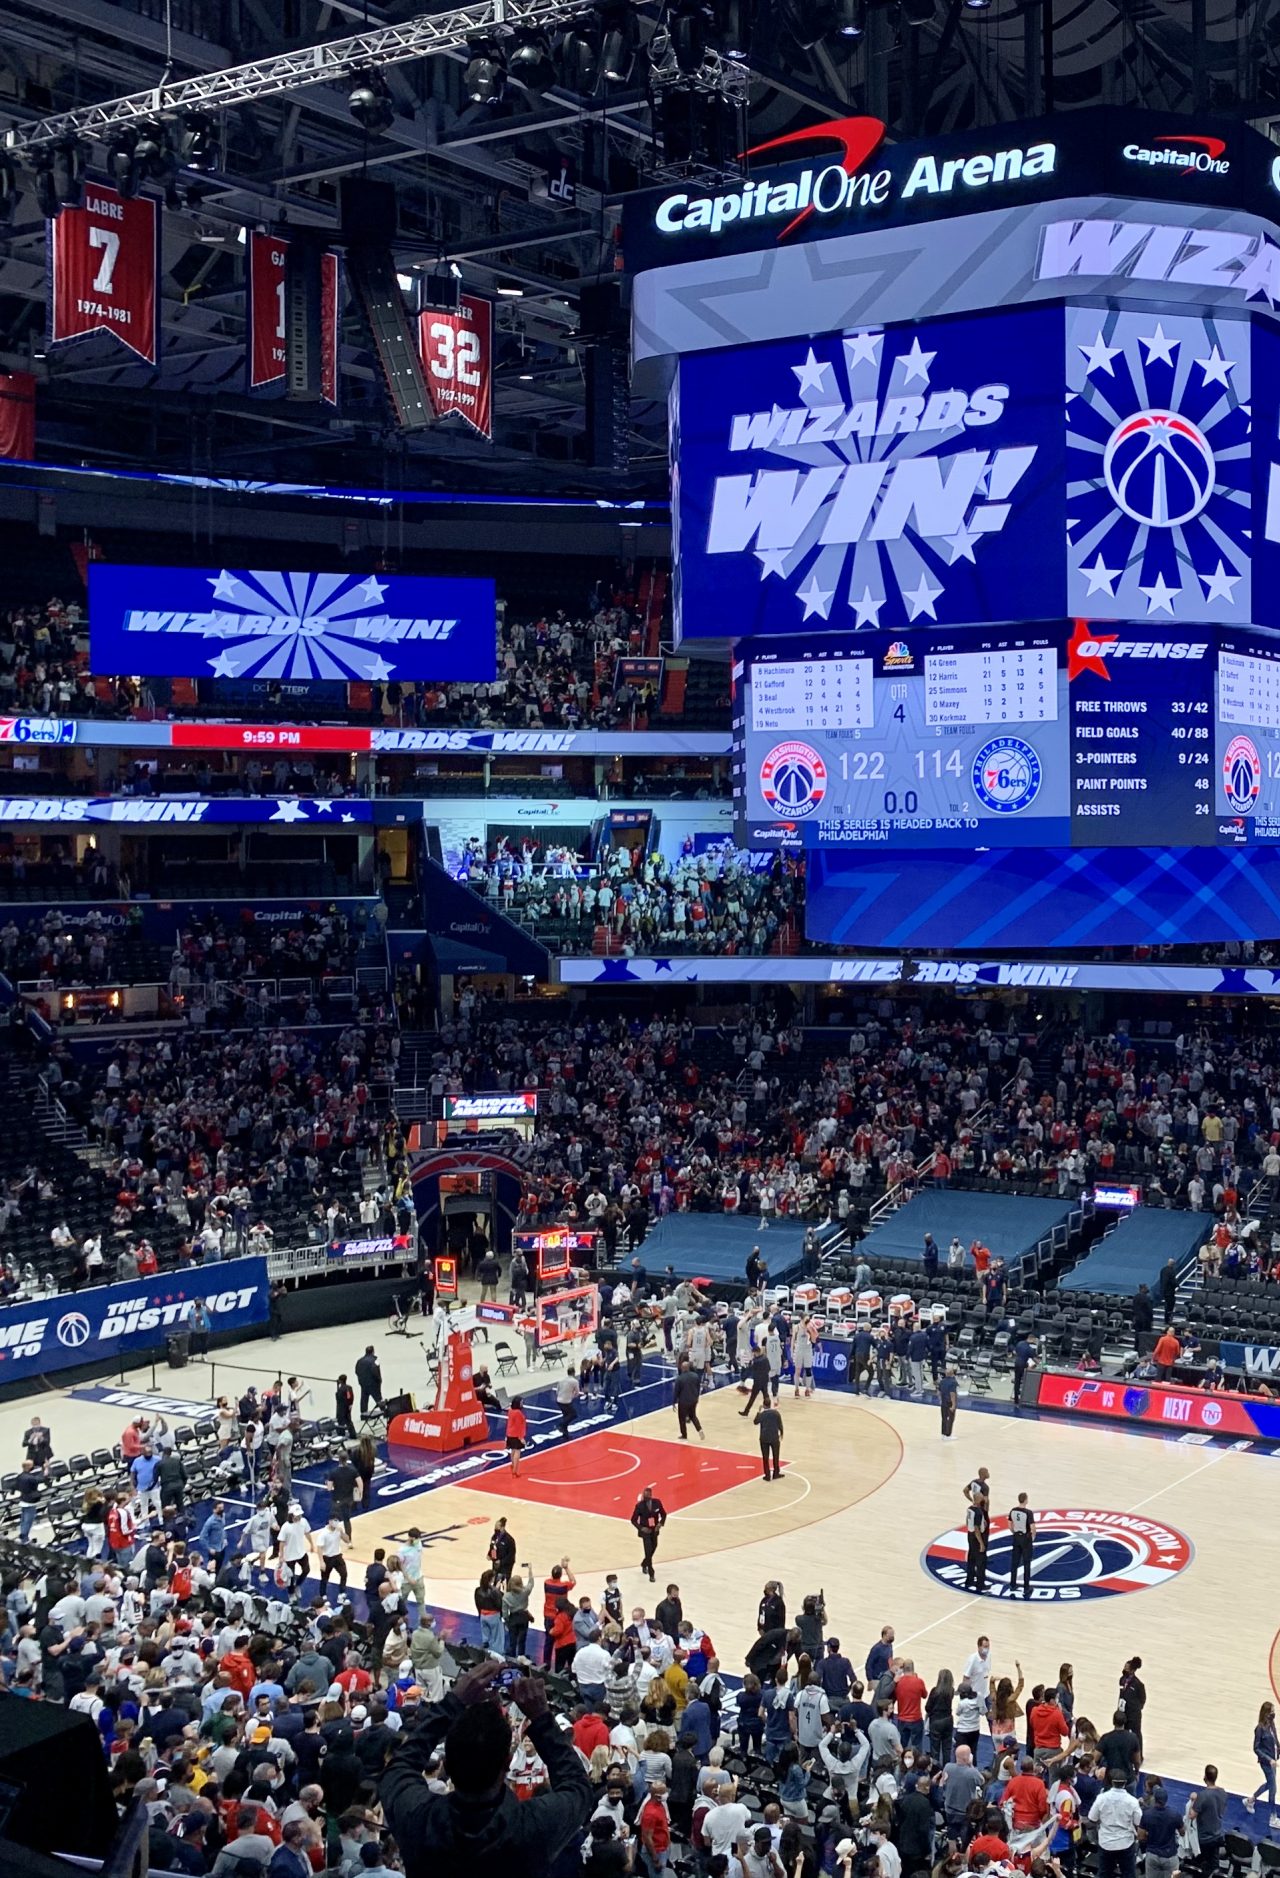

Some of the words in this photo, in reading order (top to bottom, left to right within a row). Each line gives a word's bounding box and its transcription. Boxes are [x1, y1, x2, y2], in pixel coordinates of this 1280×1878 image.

[902, 142, 1056, 199] Arena
[86, 195, 124, 221] LABRE
[89, 226, 120, 294] 7
[77, 299, 131, 324] 1974-1981
[430, 322, 481, 387] 32
[730, 384, 1009, 452] WIZARDS
[706, 446, 1038, 554] WIN!
[126, 609, 330, 636] WIZARDS
[353, 616, 458, 640] WIN!
[1076, 640, 1209, 660] OFFENSE
[938, 658, 957, 667] Green
[939, 672, 958, 680] Harris
[890, 683, 908, 701] QTR
[939, 686, 967, 694] Simmons
[764, 706, 796, 714] Westbrook
[893, 703, 906, 723] 4
[939, 700, 960, 709] Maxey
[1075, 701, 1100, 713] FREE
[1103, 701, 1148, 713] THROWS
[765, 720, 778, 728] Neto
[939, 713, 966, 722] Korkmaz
[243, 731, 276, 744] 9:59
[279, 732, 300, 744] PM
[825, 730, 838, 738] TEAM
[943, 726, 958, 735] TEAM
[959, 725, 976, 734] FOULS
[1075, 727, 1103, 738] FIELD
[1105, 727, 1139, 738] GOALS
[491, 732, 577, 751] WIN!
[767, 743, 818, 764] WASHINGTON
[974, 739, 1038, 776] PHILADELPHIA
[1076, 752, 1137, 764] 3-POINTERS
[839, 751, 885, 780] 122
[915, 749, 964, 778] 114
[985, 768, 1027, 789] 76ers
[1076, 778, 1106, 790] PAINT
[1109, 778, 1148, 790] POINTS
[1195, 778, 1209, 789] 48
[773, 800, 815, 817] WIZARDS
[884, 790, 918, 814] 0.0
[962, 802, 969, 812] 2
[1076, 804, 1121, 815] ASSISTS
[1195, 804, 1209, 815] 24
[110, 801, 209, 822] WIN!
[818, 820, 841, 830] THIS
[843, 819, 878, 830] SERIES
[880, 819, 890, 829] IS
[893, 818, 933, 829] HEADED
[935, 818, 962, 829] BACK
[964, 818, 979, 828] TO
[1254, 816, 1267, 827] THIS
[818, 830, 889, 841] PHILADELPHIA!
[997, 962, 1079, 986] WIN!
[451, 1105, 499, 1116] ABOVE
[501, 1104, 528, 1114] ALL
[454, 1097, 527, 1107] PLAYOFFS
[343, 1246, 374, 1256] ABOVE
[376, 1245, 394, 1254] ALL
[345, 1238, 394, 1250] PLAYOFFS
[107, 1296, 148, 1317] THE
[11, 1341, 42, 1359] TO
[1102, 1390, 1114, 1407] VS
[1162, 1397, 1193, 1421] NEXT
[1203, 1407, 1222, 1420] TNT
[455, 1410, 483, 1431] PLAYOFFS
[805, 1710, 811, 1724] 4
